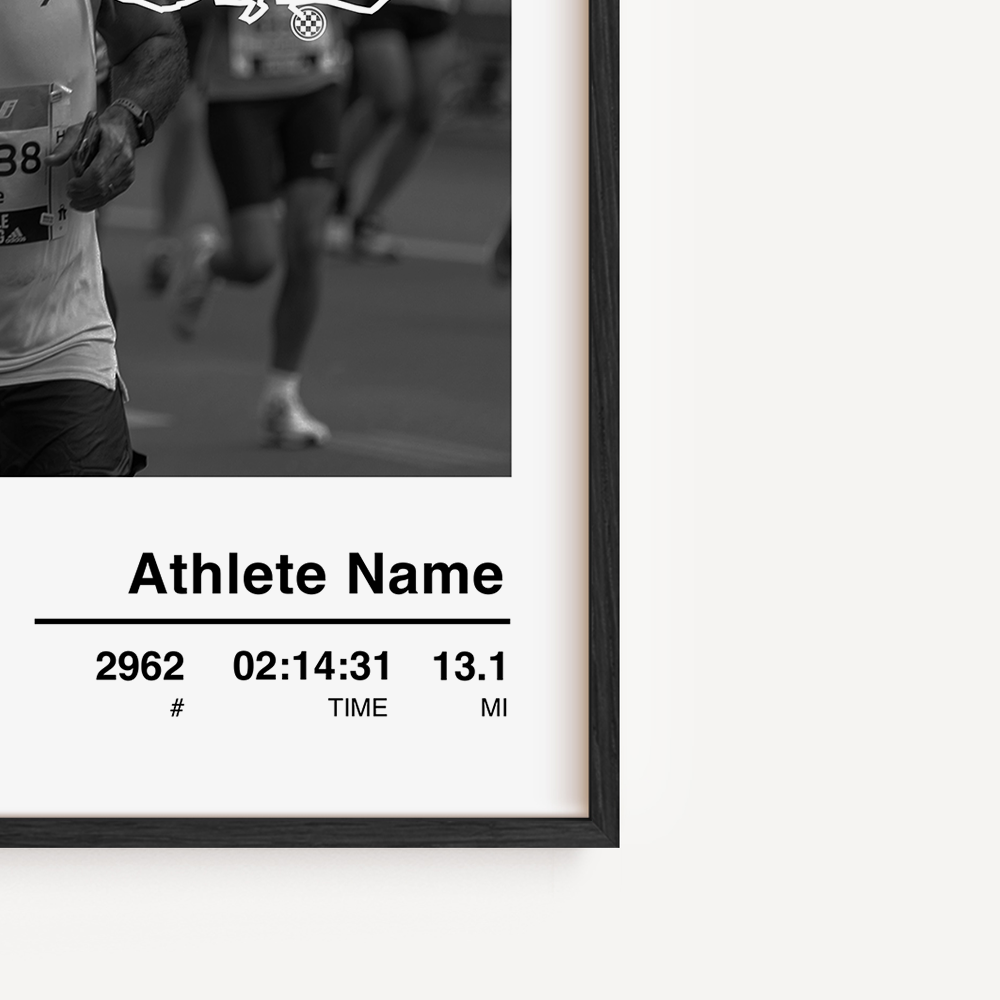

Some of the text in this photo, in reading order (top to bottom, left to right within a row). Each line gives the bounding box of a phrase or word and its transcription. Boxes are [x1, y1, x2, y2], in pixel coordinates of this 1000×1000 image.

[127, 552, 504, 596] Athlete Name
[95, 650, 504, 682] 2962 02:14:31 13.1
[169, 697, 507, 718] # TIME MI
